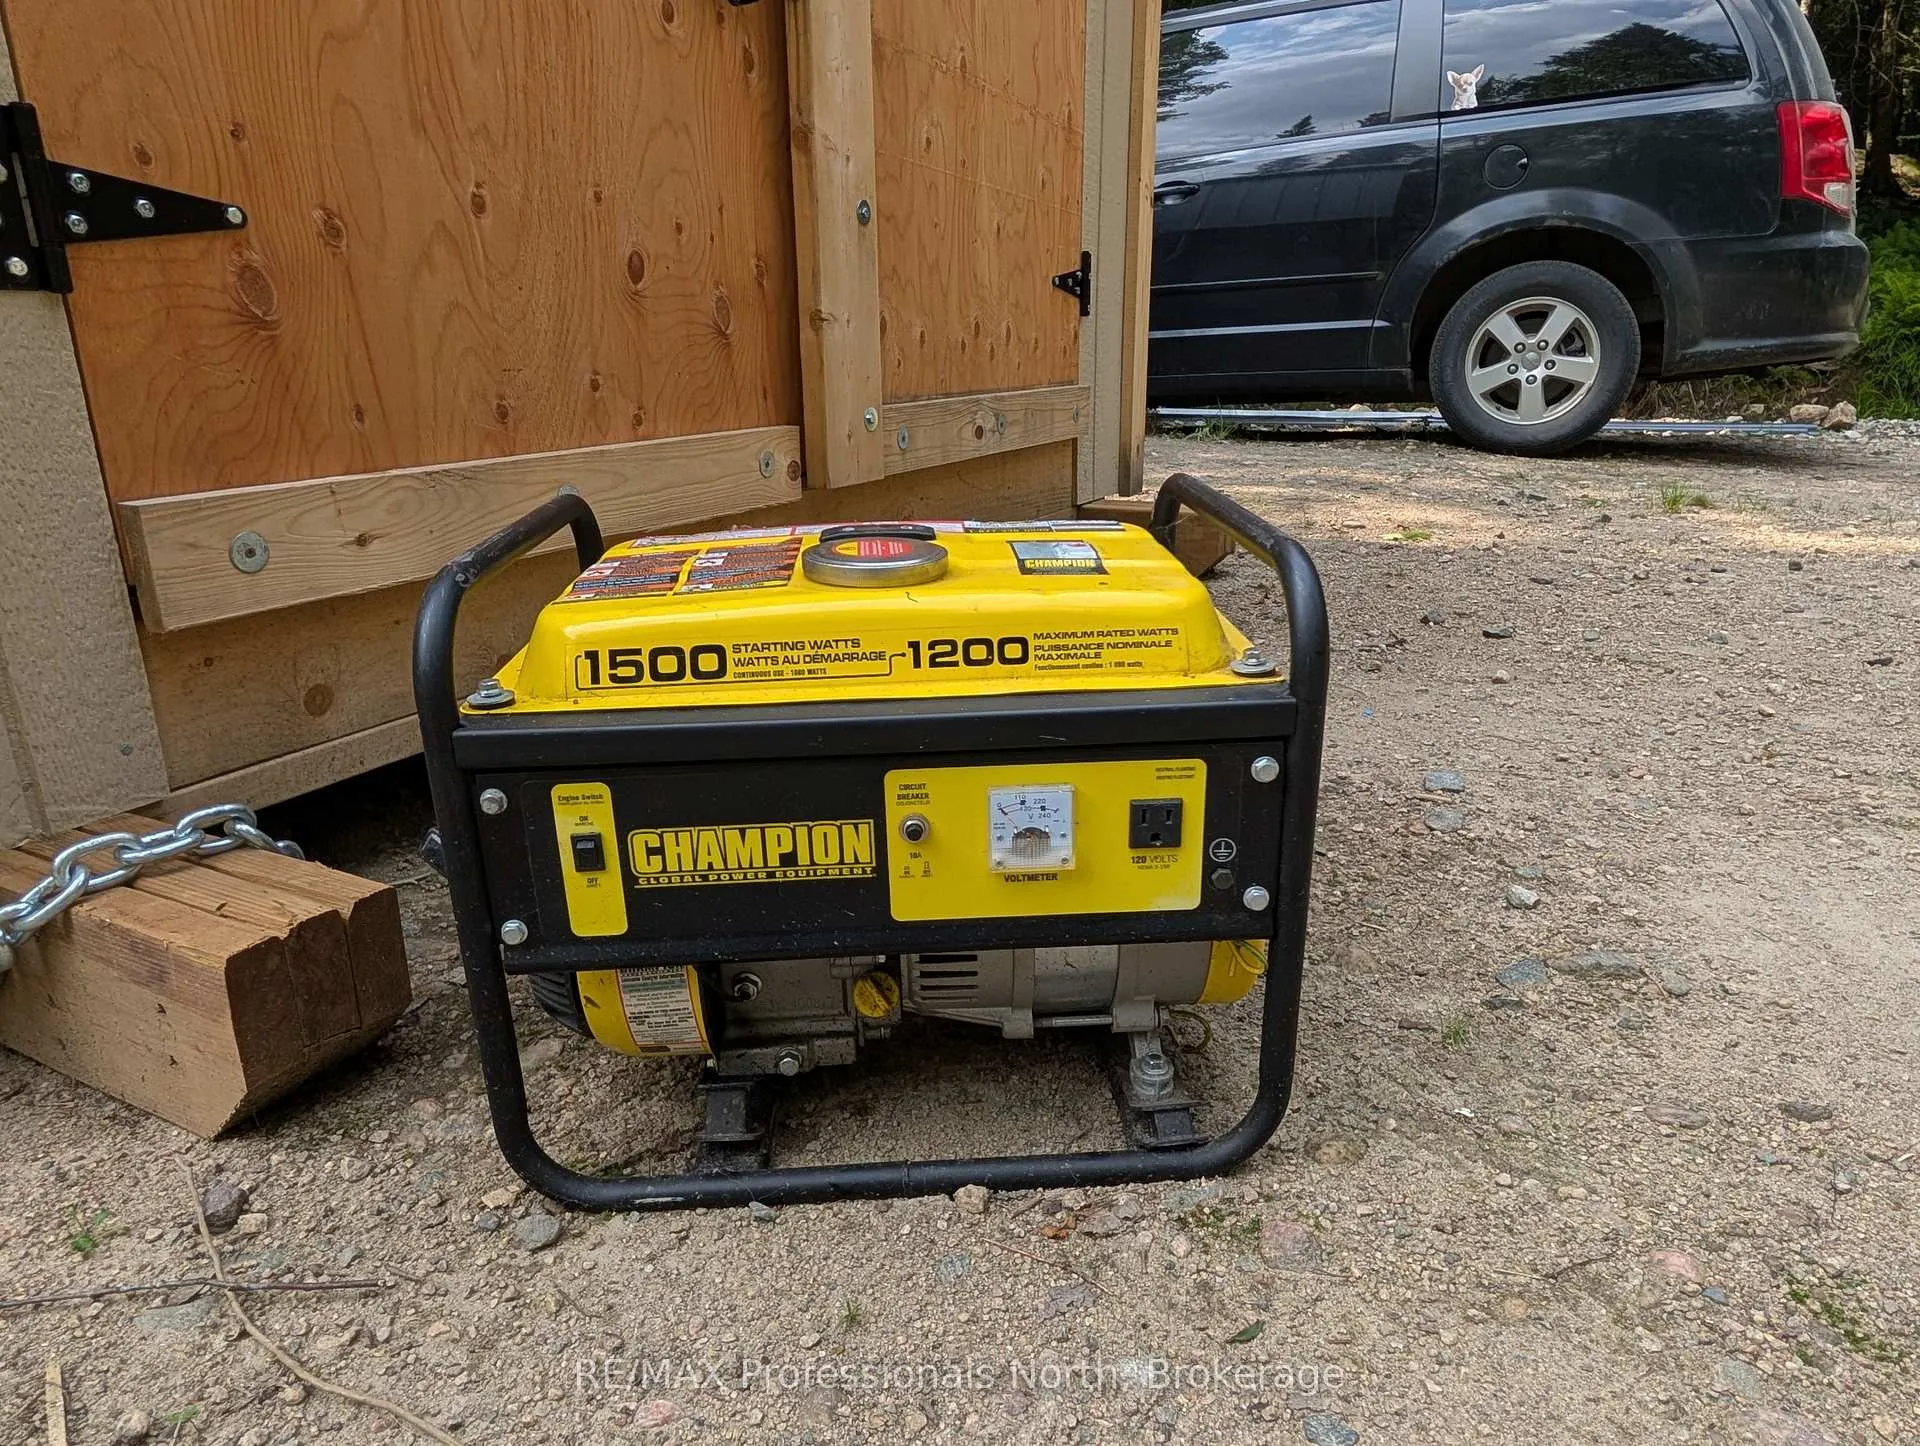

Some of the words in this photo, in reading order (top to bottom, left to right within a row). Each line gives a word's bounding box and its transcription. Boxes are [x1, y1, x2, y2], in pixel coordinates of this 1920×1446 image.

[1024, 559, 1096, 568] CHAMPION
[1033, 631, 1095, 641] MAXIMUM
[1096, 629, 1136, 639] RATED
[1137, 627, 1179, 637] WATTS
[732, 640, 805, 654] STARTING
[808, 638, 861, 650] WATTS
[1034, 642, 1104, 653] PUISSANCE
[1106, 640, 1173, 650] NOMINALE
[733, 655, 779, 668] WATTS
[782, 654, 800, 665] AU
[803, 650, 886, 664] DÉMARRAGE
[907, 636, 1029, 670] 1200
[1034, 652, 1102, 661] MAXIMALE
[584, 644, 728, 685] 1500
[807, 668, 827, 676] WATTS
[898, 783, 927, 791] CIRCUIT
[581, 792, 604, 801] Switch
[896, 793, 930, 801] BREAKER
[632, 822, 871, 873] CHAMPION
[1131, 855, 1147, 864] 120
[1148, 854, 1178, 864] VOLTS
[638, 875, 703, 885] GLOBAL
[708, 872, 767, 882] POWER
[775, 867, 873, 879] EQUIPMENT
[1003, 872, 1058, 883] VOLTMETER
